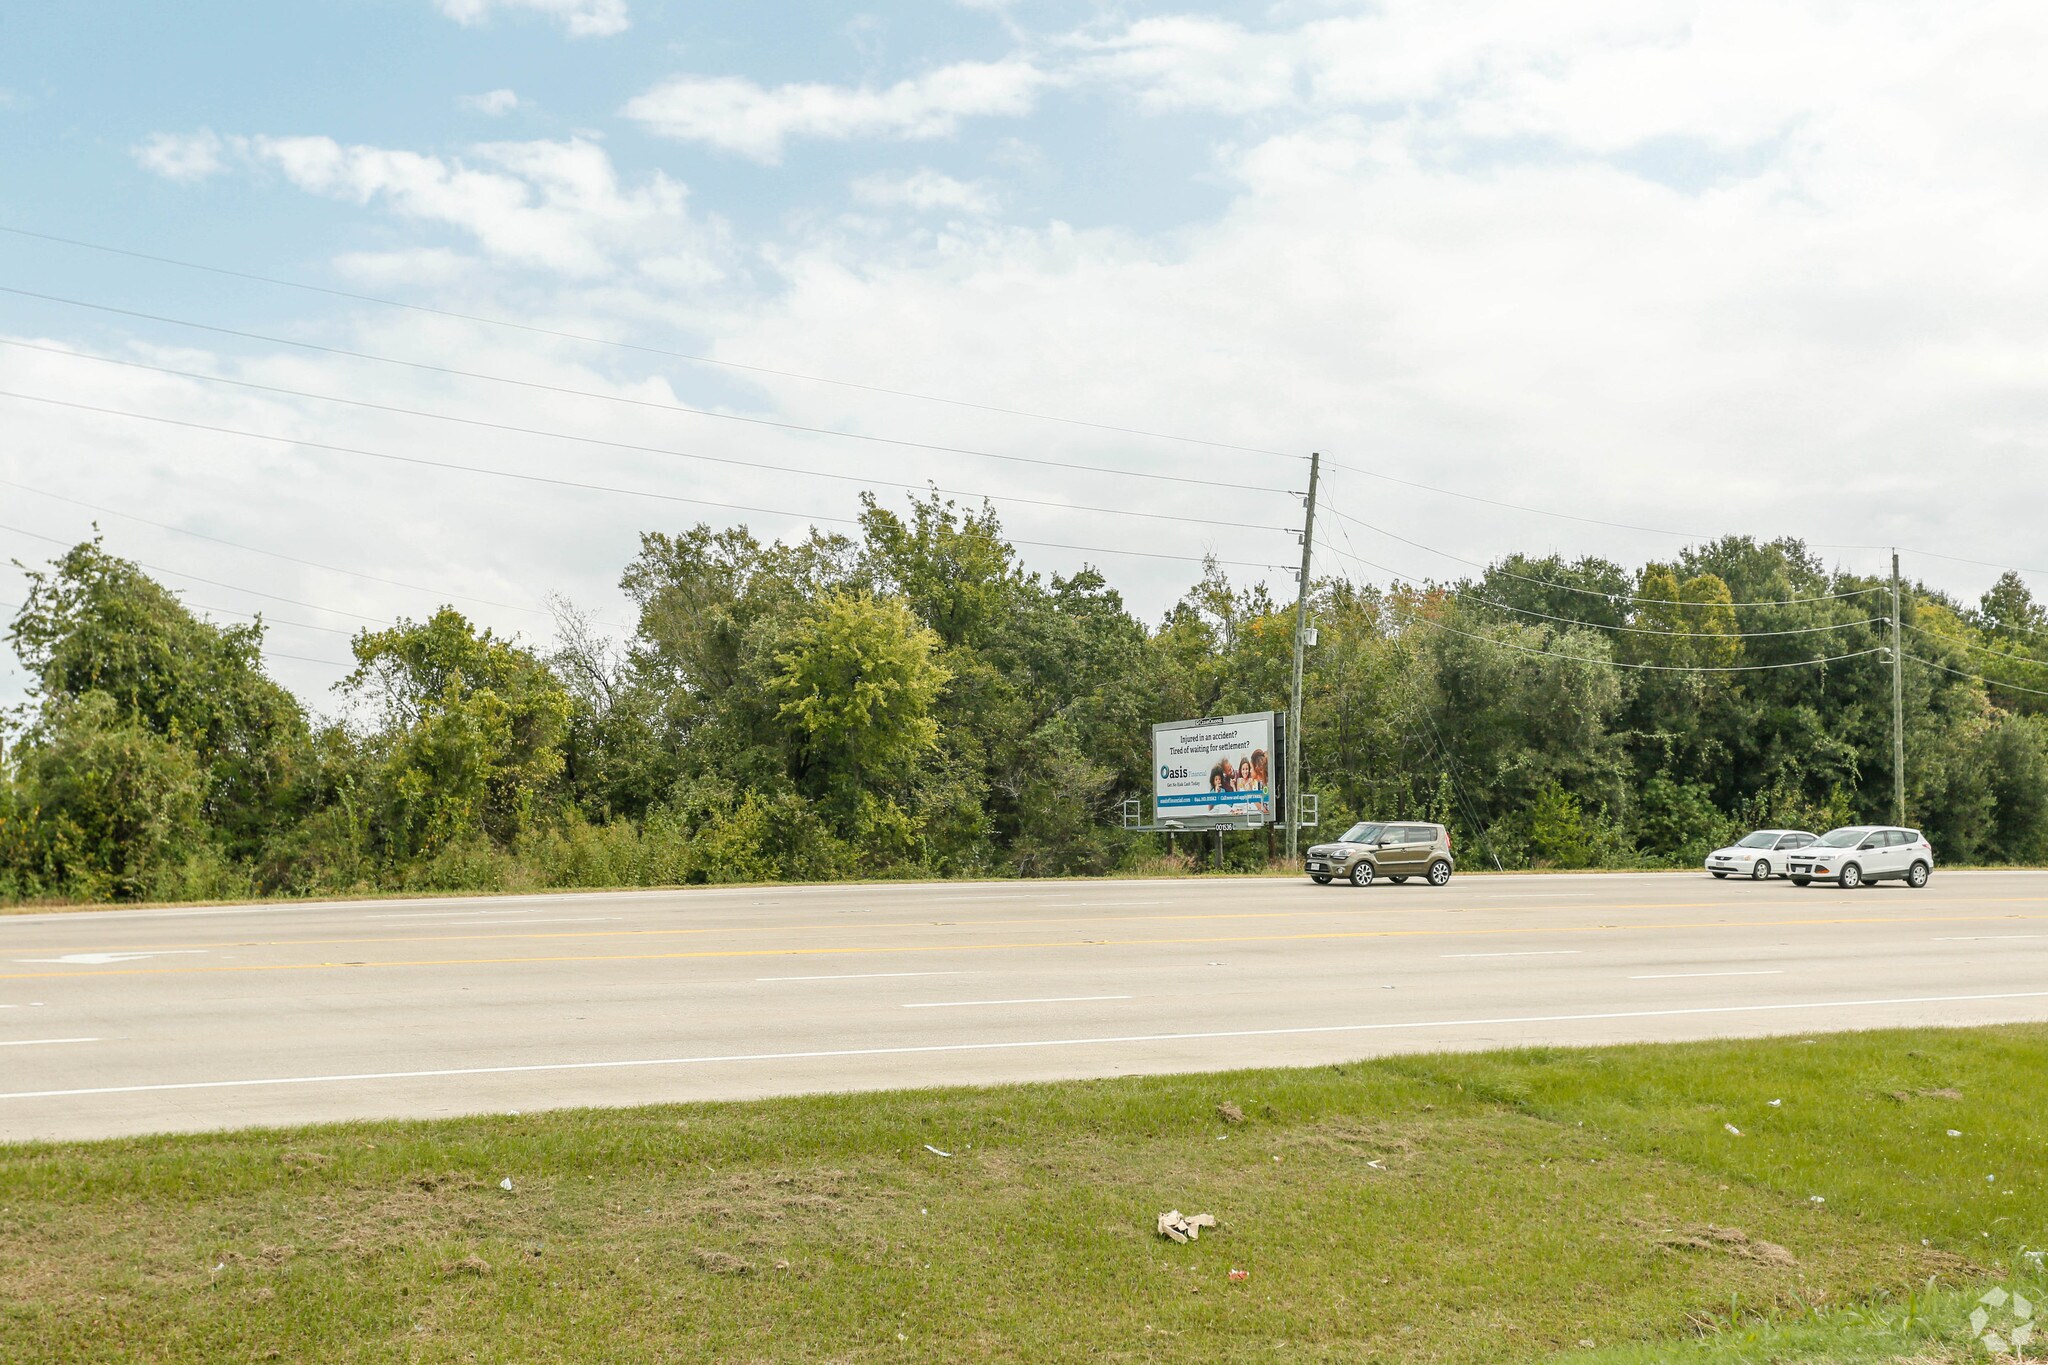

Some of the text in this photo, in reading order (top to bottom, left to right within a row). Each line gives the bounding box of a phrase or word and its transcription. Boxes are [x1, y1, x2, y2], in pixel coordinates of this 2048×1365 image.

[1180, 734, 1198, 744] Injured
[1212, 731, 1238, 740] accident?
[1170, 747, 1183, 755] Tired
[1184, 746, 1190, 754] of
[1190, 745, 1209, 754] waiting
[1219, 741, 1250, 750] settlement?
[1161, 765, 1188, 779] Oasis
